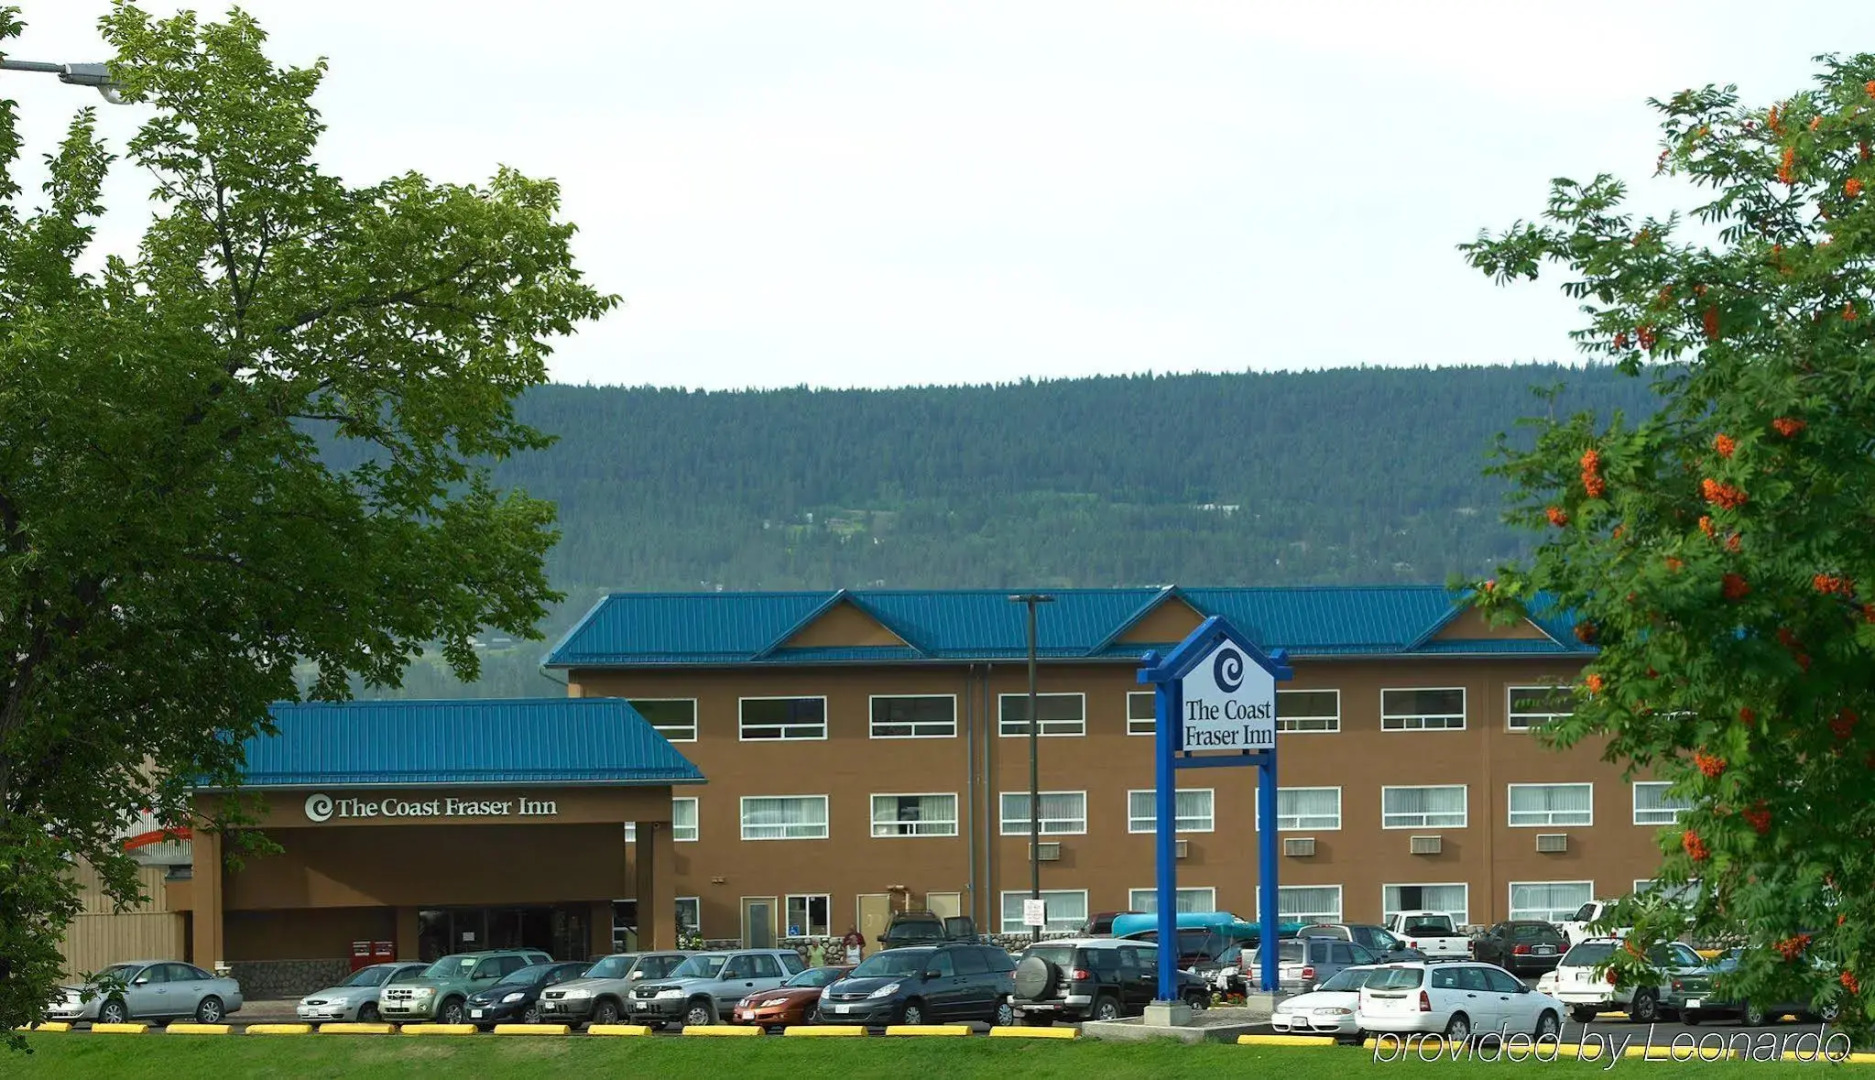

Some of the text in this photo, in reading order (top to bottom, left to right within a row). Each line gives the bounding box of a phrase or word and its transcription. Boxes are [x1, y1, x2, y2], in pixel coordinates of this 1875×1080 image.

[1186, 698, 1271, 721] The Coast
[1185, 725, 1273, 746] Fraser Inn
[335, 797, 558, 818] The Coast Fraser Inn
